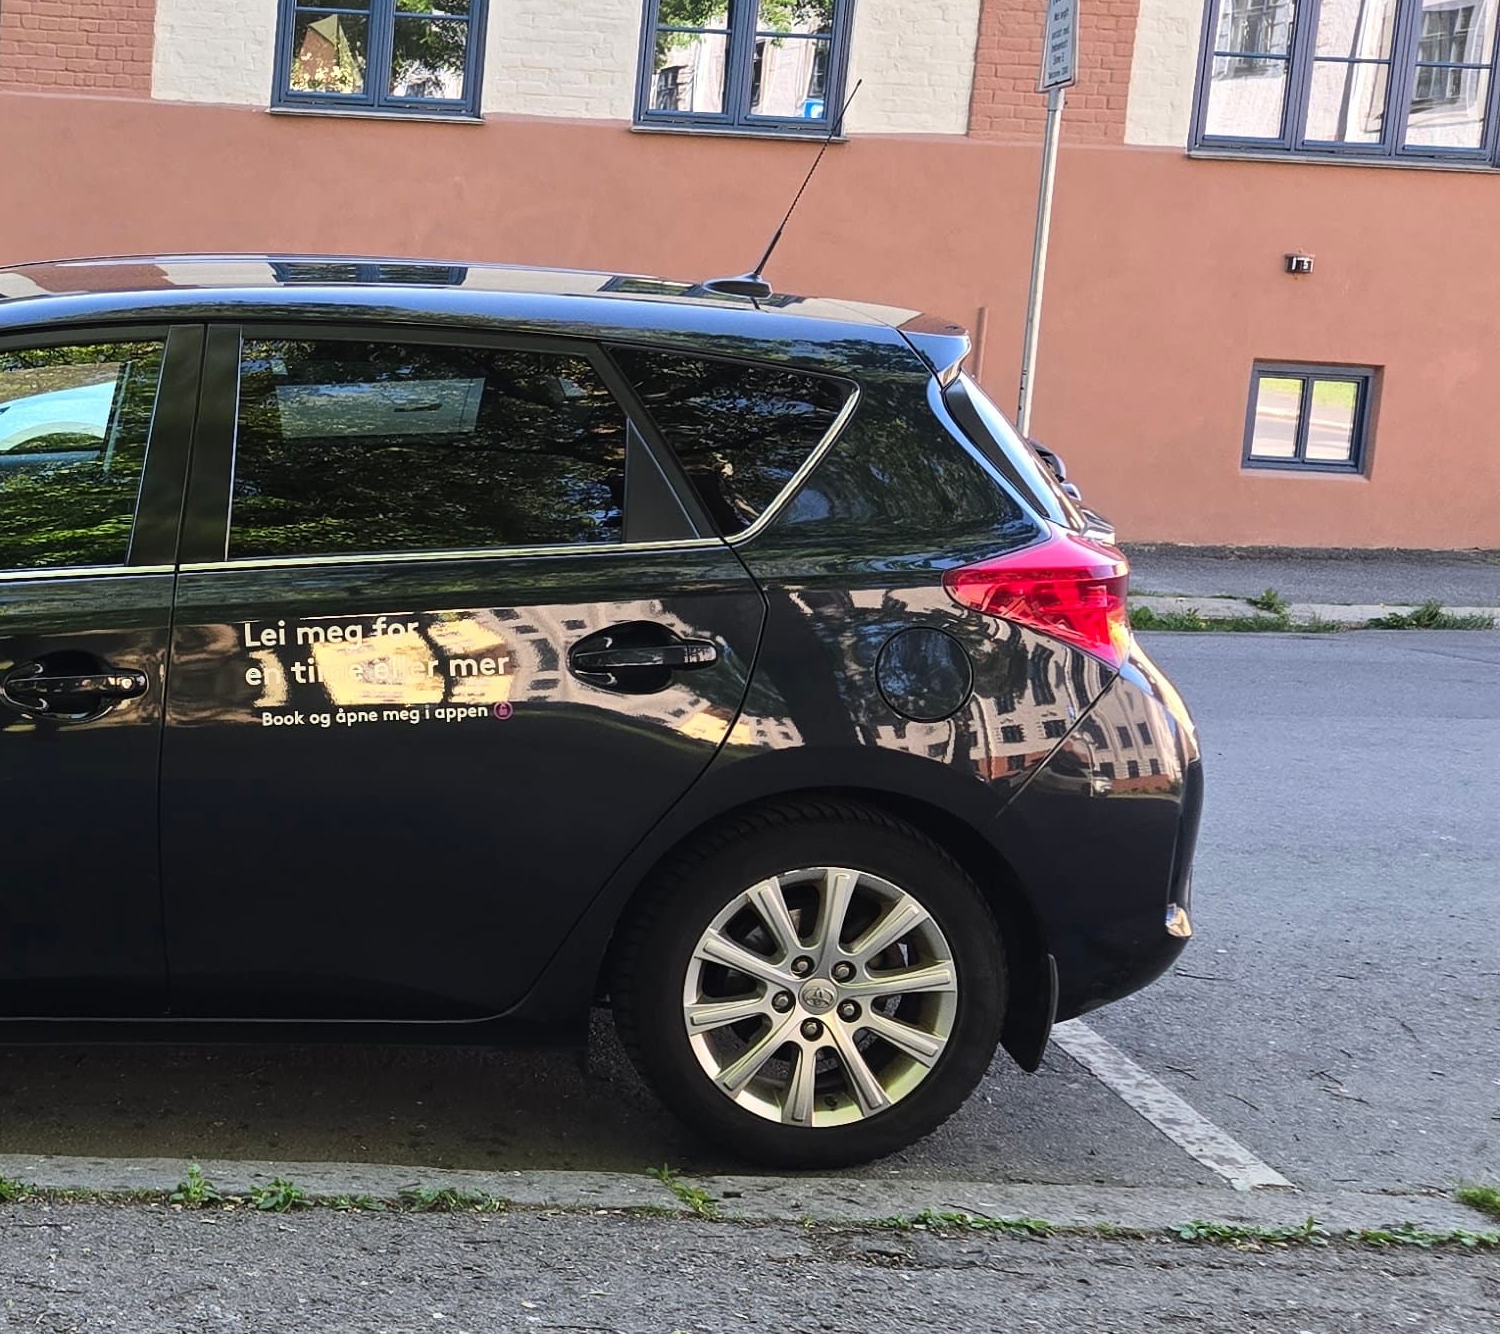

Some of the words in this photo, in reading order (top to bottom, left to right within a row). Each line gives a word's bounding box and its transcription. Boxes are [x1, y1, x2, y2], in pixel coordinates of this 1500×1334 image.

[244, 619, 286, 647] Lei
[296, 624, 363, 653] meg
[372, 617, 420, 641] for
[245, 665, 282, 686] en
[449, 656, 510, 677] mer
[262, 710, 305, 727] Book
[309, 713, 331, 728] og
[335, 708, 379, 727] åpne
[383, 709, 420, 724] meg
[424, 704, 430, 719] i
[434, 705, 489, 723] appen
